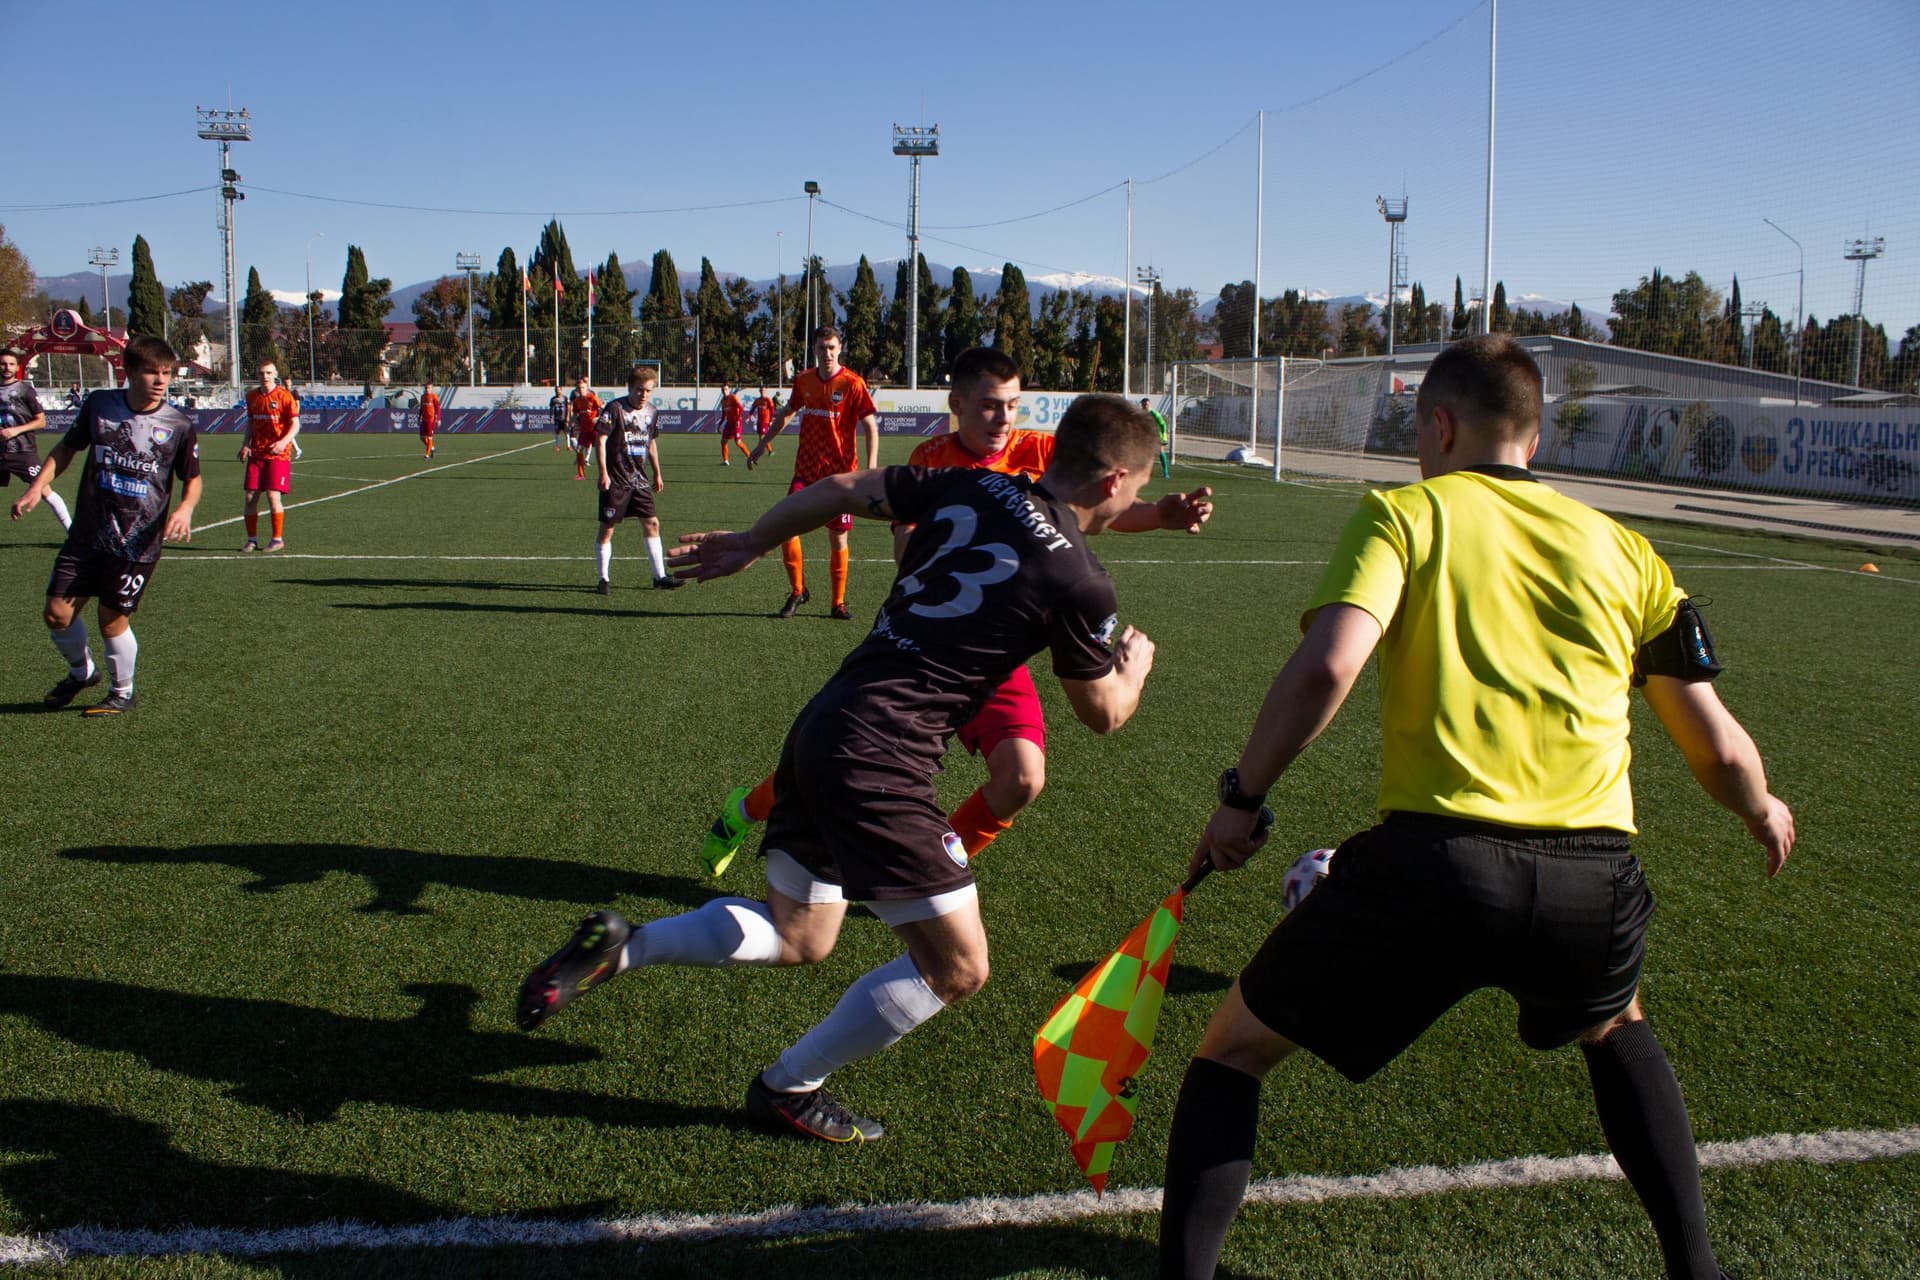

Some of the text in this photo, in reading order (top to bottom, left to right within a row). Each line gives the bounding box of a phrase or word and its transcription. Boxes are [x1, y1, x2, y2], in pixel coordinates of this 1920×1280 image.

[898, 405, 931, 413] xiaomi
[1035, 397, 1049, 424] 3
[1783, 417, 1920, 474] 3 УНИКАЛЬН
[898, 504, 1020, 618] 23
[118, 574, 145, 596] 29
